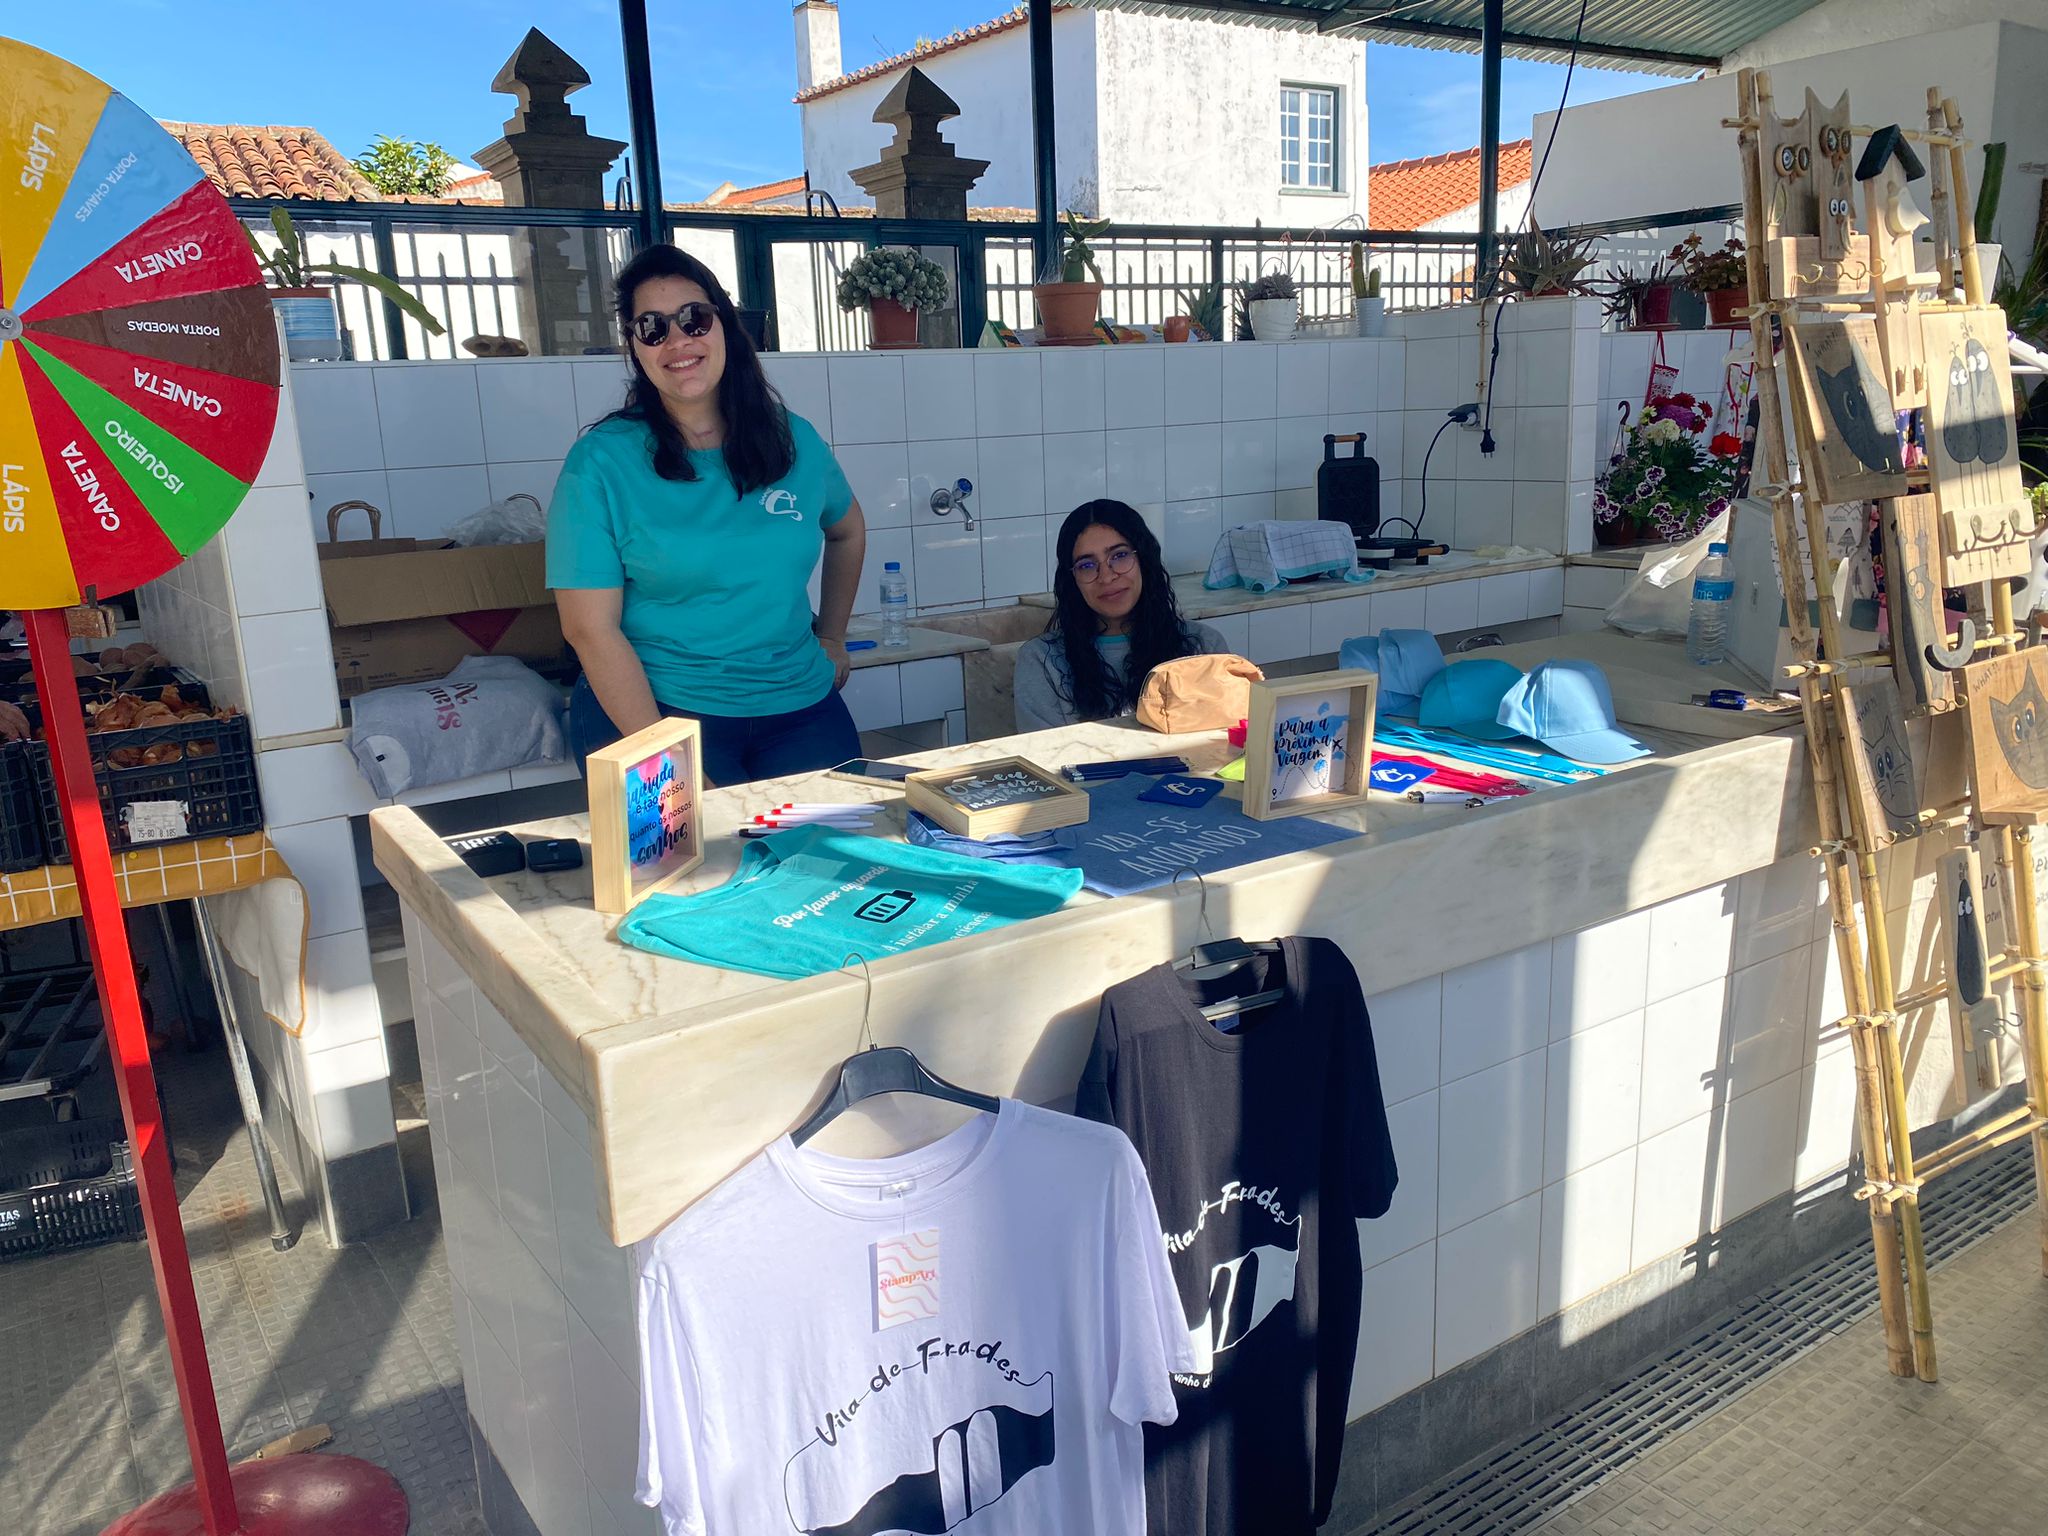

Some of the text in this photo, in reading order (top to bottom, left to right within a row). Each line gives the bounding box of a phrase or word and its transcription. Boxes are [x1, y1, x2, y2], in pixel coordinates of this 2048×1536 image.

[21, 122, 55, 191] LÁPIS
[75, 151, 139, 222] PORTA CHAVES
[114, 242, 202, 284] CANETA
[127, 320, 220, 337] PORTA MOEDAS
[133, 367, 222, 417] CANETA
[104, 419, 185, 494] ISQUEIRO
[2, 464, 30, 533] LÁPIS
[60, 440, 121, 532] CANETA
[1279, 718, 1329, 737] Para a
[1278, 750, 1326, 767] Viagem
[660, 781, 685, 801] nosso
[630, 822, 657, 841] quanto
[668, 800, 692, 819] nossos
[1085, 815, 1203, 853] VAI-SE
[1119, 824, 1262, 877] ANDANDO
[944, 879, 979, 913] minha
[1221, 1181, 1285, 1223] Frades
[815, 1337, 1020, 1447] Vila de Frades
[1174, 1373, 1200, 1387] vinho
